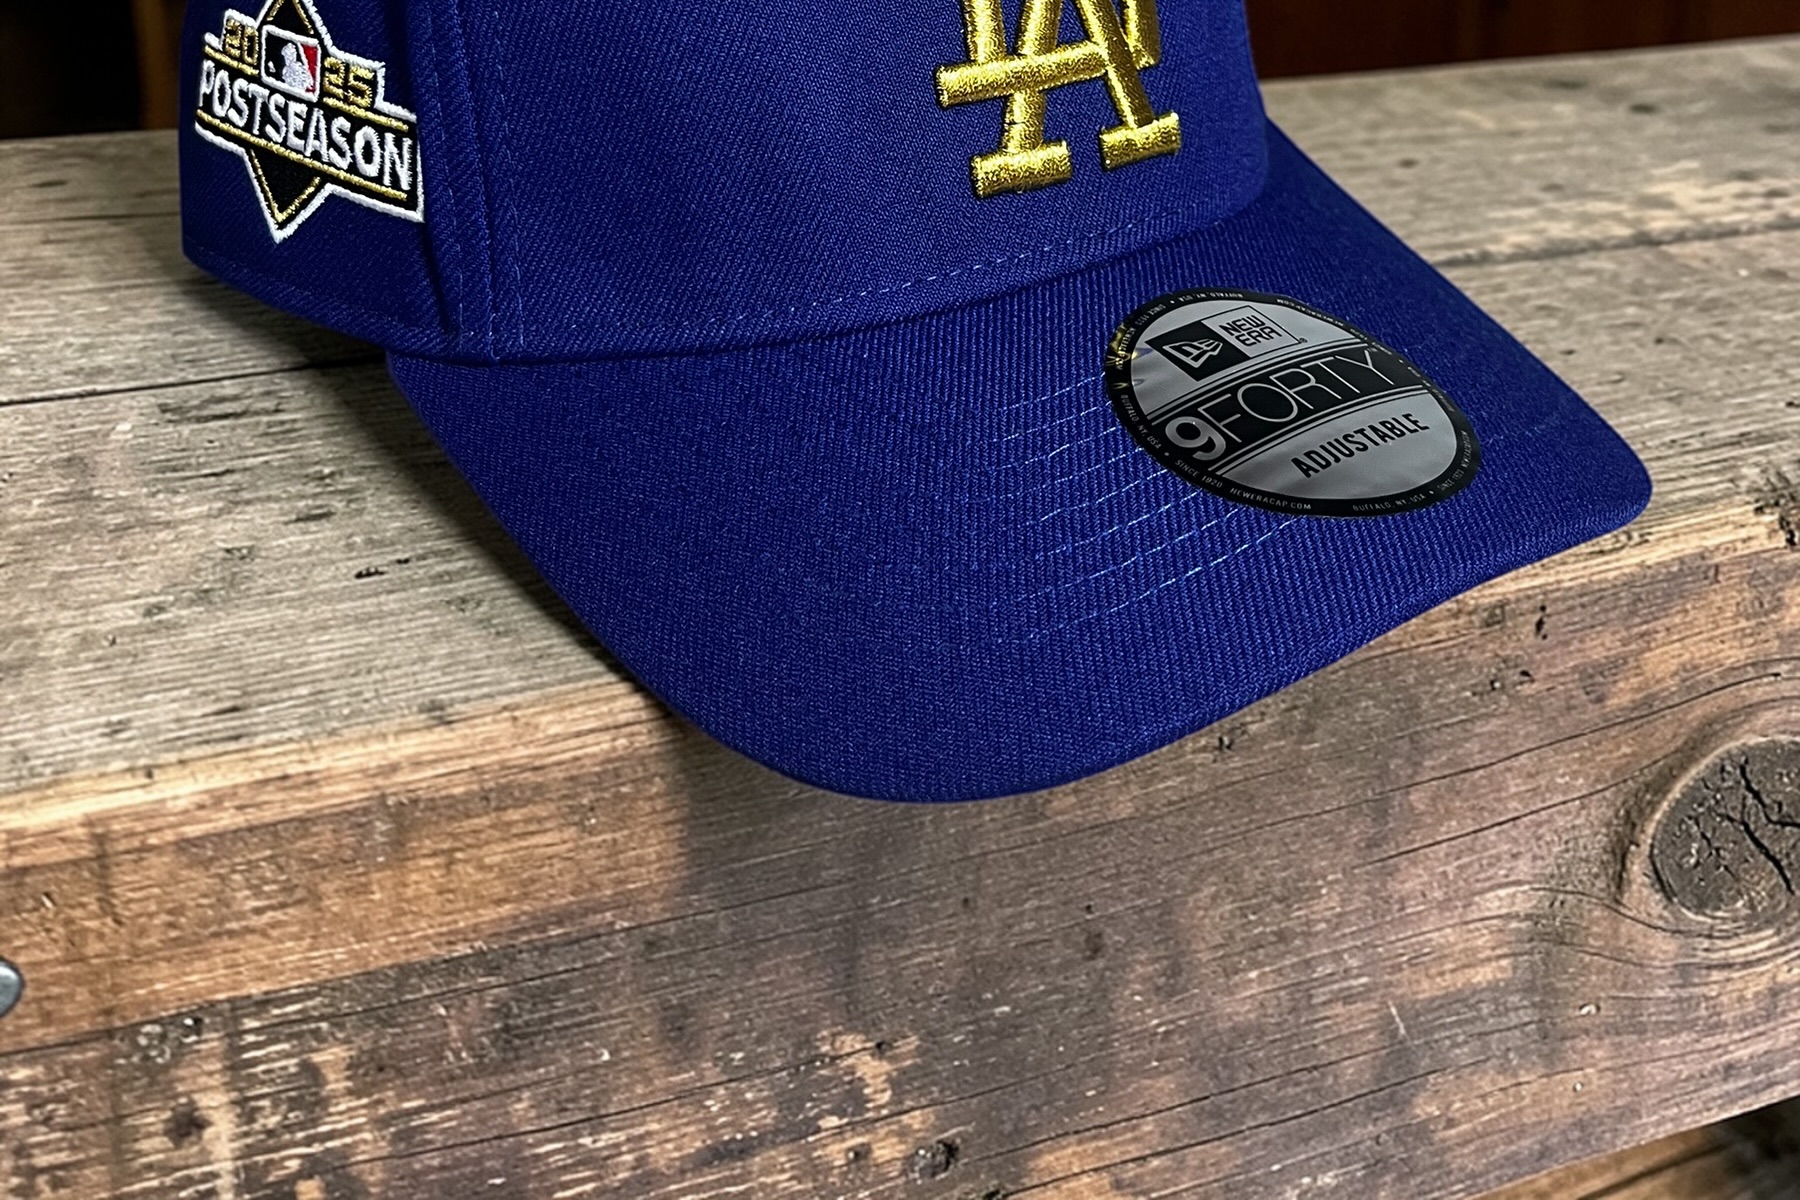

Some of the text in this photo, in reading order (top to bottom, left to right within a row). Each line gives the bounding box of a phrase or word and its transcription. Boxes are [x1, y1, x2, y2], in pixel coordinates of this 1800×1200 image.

[322, 56, 376, 108] 25
[199, 59, 414, 191] POSTSEASON
[1218, 314, 1267, 337] NEW
[1234, 325, 1283, 347] ERA
[1165, 349, 1396, 461] 9FORTY
[1290, 412, 1431, 479] ADJUSTABLE
[1174, 459, 1201, 478] SINCE
[1229, 487, 1312, 510] NEWERACAP.COM
